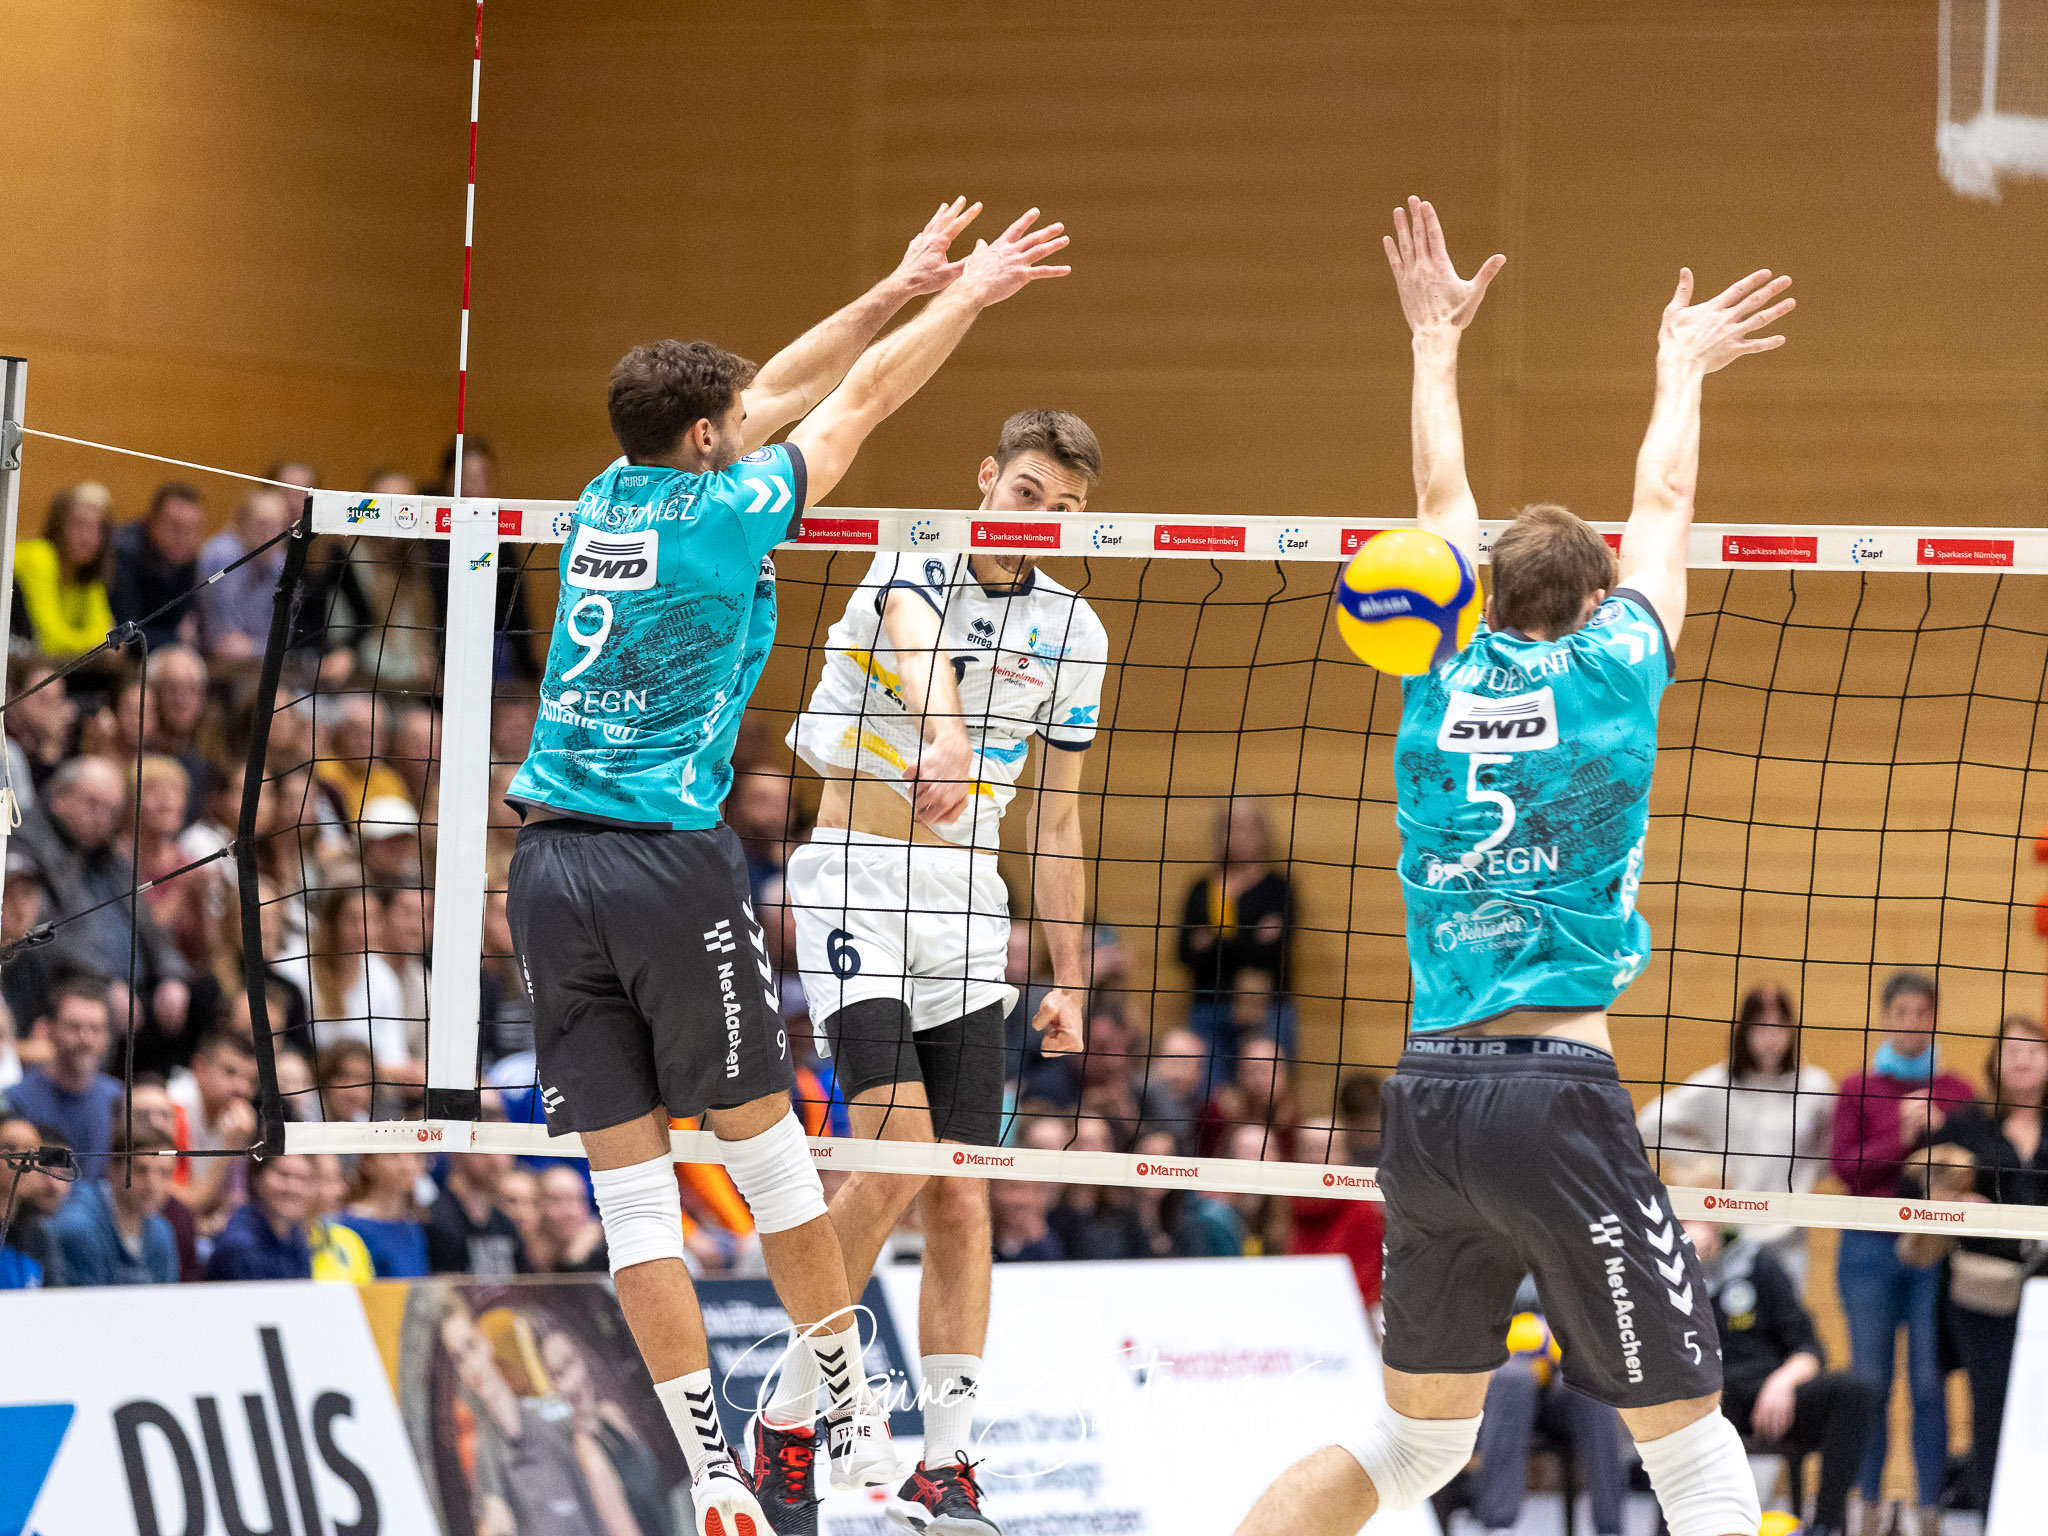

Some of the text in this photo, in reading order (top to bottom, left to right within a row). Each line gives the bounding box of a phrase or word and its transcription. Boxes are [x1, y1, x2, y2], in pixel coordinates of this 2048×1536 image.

[346, 506, 381, 520] HUCK
[560, 523, 572, 532] Za
[808, 529, 841, 539] Sparkasse
[841, 529, 872, 540] Nürnberg
[919, 531, 940, 542] Zapf
[989, 532, 1022, 542] Sparkasse
[1023, 533, 1054, 544] Nürnberg
[1101, 535, 1123, 546] Zapf
[1172, 536, 1206, 545] Sparkasse
[1207, 536, 1239, 547] Nürnberg
[1286, 539, 1309, 550] Zapf
[1477, 542, 1493, 554] Zap
[1742, 547, 1777, 557] Sparkasse
[1777, 547, 1811, 558] Nürnberg
[1861, 549, 1883, 560] Zapf
[1937, 550, 1972, 560] Sparkasse
[1973, 550, 2007, 561] Nürnberg
[470, 560, 491, 568] HUCK
[570, 554, 648, 580] SWD
[561, 594, 614, 683] 9
[990, 665, 1044, 688] Heinzelmann
[584, 689, 648, 714] EGN
[1448, 716, 1547, 740] SWD
[1466, 752, 1516, 853] 5
[1487, 845, 1559, 876] EGN
[826, 928, 862, 981] 6
[717, 961, 743, 1079] NetAachen
[776, 1029, 787, 1061] 9
[809, 1147, 834, 1158] mot
[966, 1153, 1016, 1167] Marmot
[1150, 1164, 1200, 1178] Marmot
[1718, 1197, 1769, 1211] Marmot
[1913, 1208, 1966, 1222] Marmot
[1604, 1256, 1644, 1384] NetAachen
[1683, 1330, 1702, 1366] 5
[111, 1325, 383, 1536] puls
